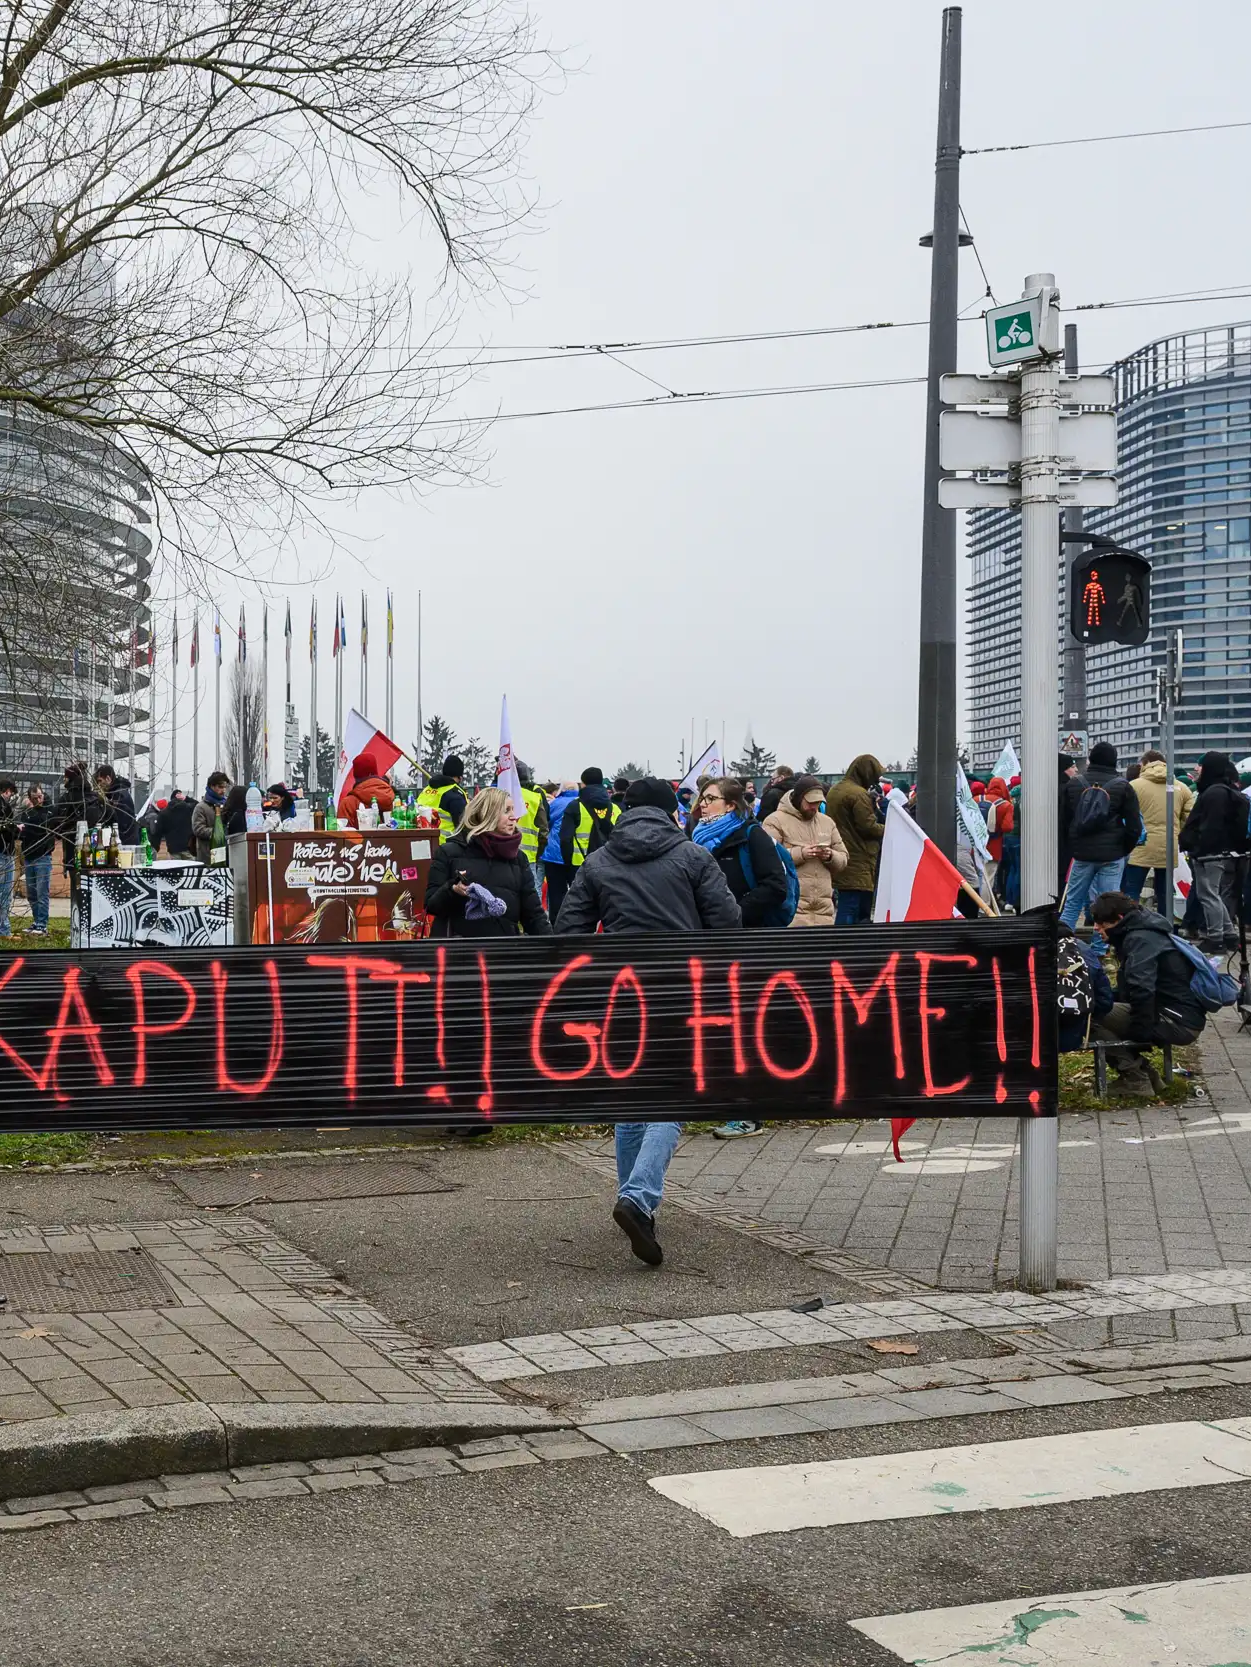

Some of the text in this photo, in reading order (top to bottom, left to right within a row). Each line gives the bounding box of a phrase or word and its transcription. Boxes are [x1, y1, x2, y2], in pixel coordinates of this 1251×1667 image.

[339, 844, 362, 861] us
[530, 953, 647, 1081] GO
[686, 946, 1041, 1114] HOME!!
